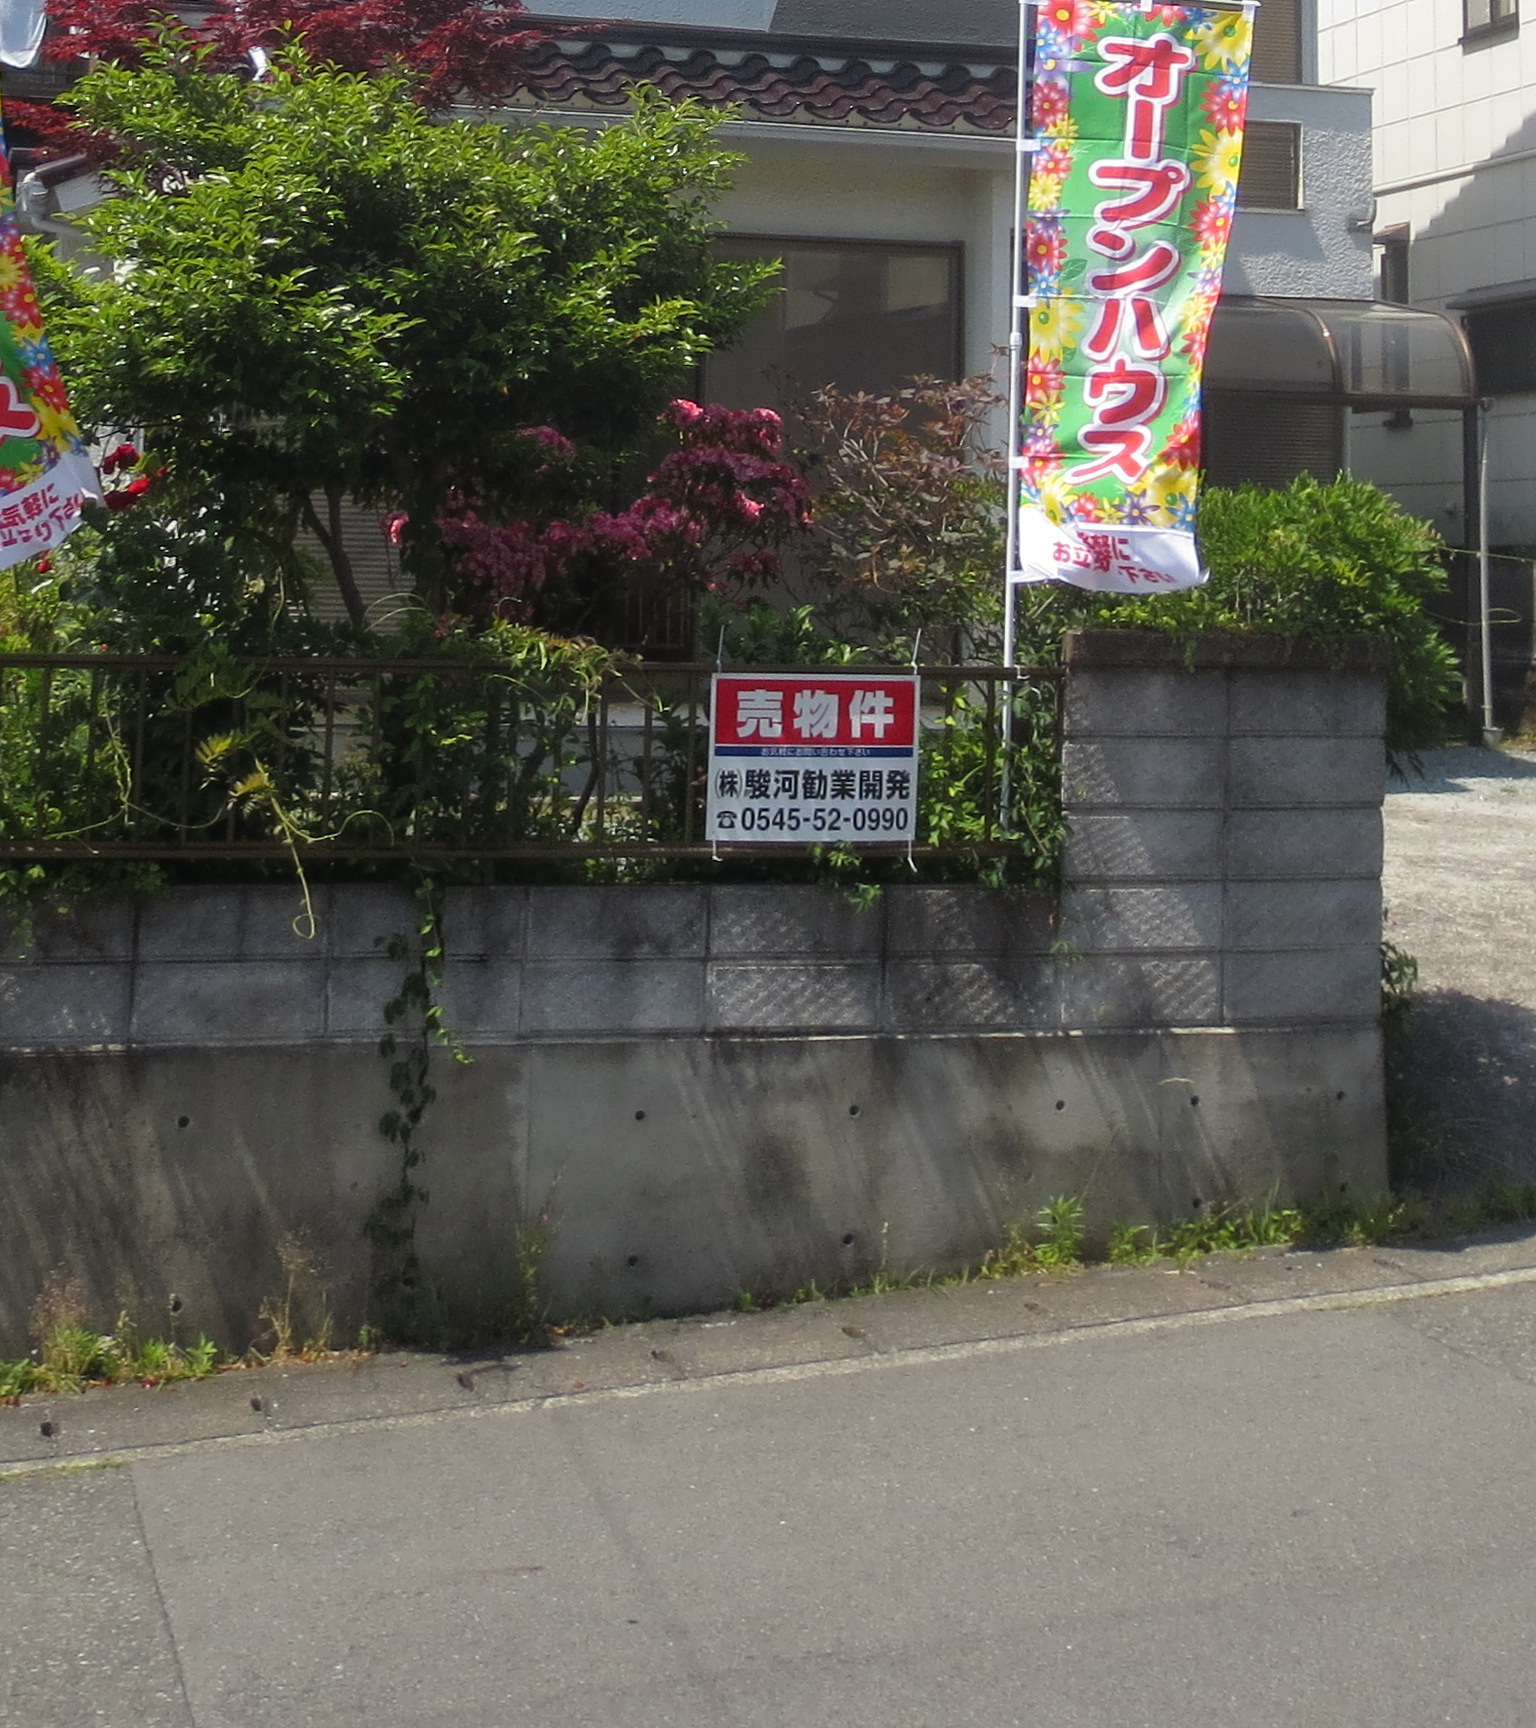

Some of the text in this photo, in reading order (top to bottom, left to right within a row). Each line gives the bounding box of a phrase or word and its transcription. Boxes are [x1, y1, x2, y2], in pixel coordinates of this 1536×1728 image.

[1066, 34, 1197, 486] オープンハウス
[736, 688, 895, 739] 売物件
[741, 807, 909, 831] 0545-52-0990
